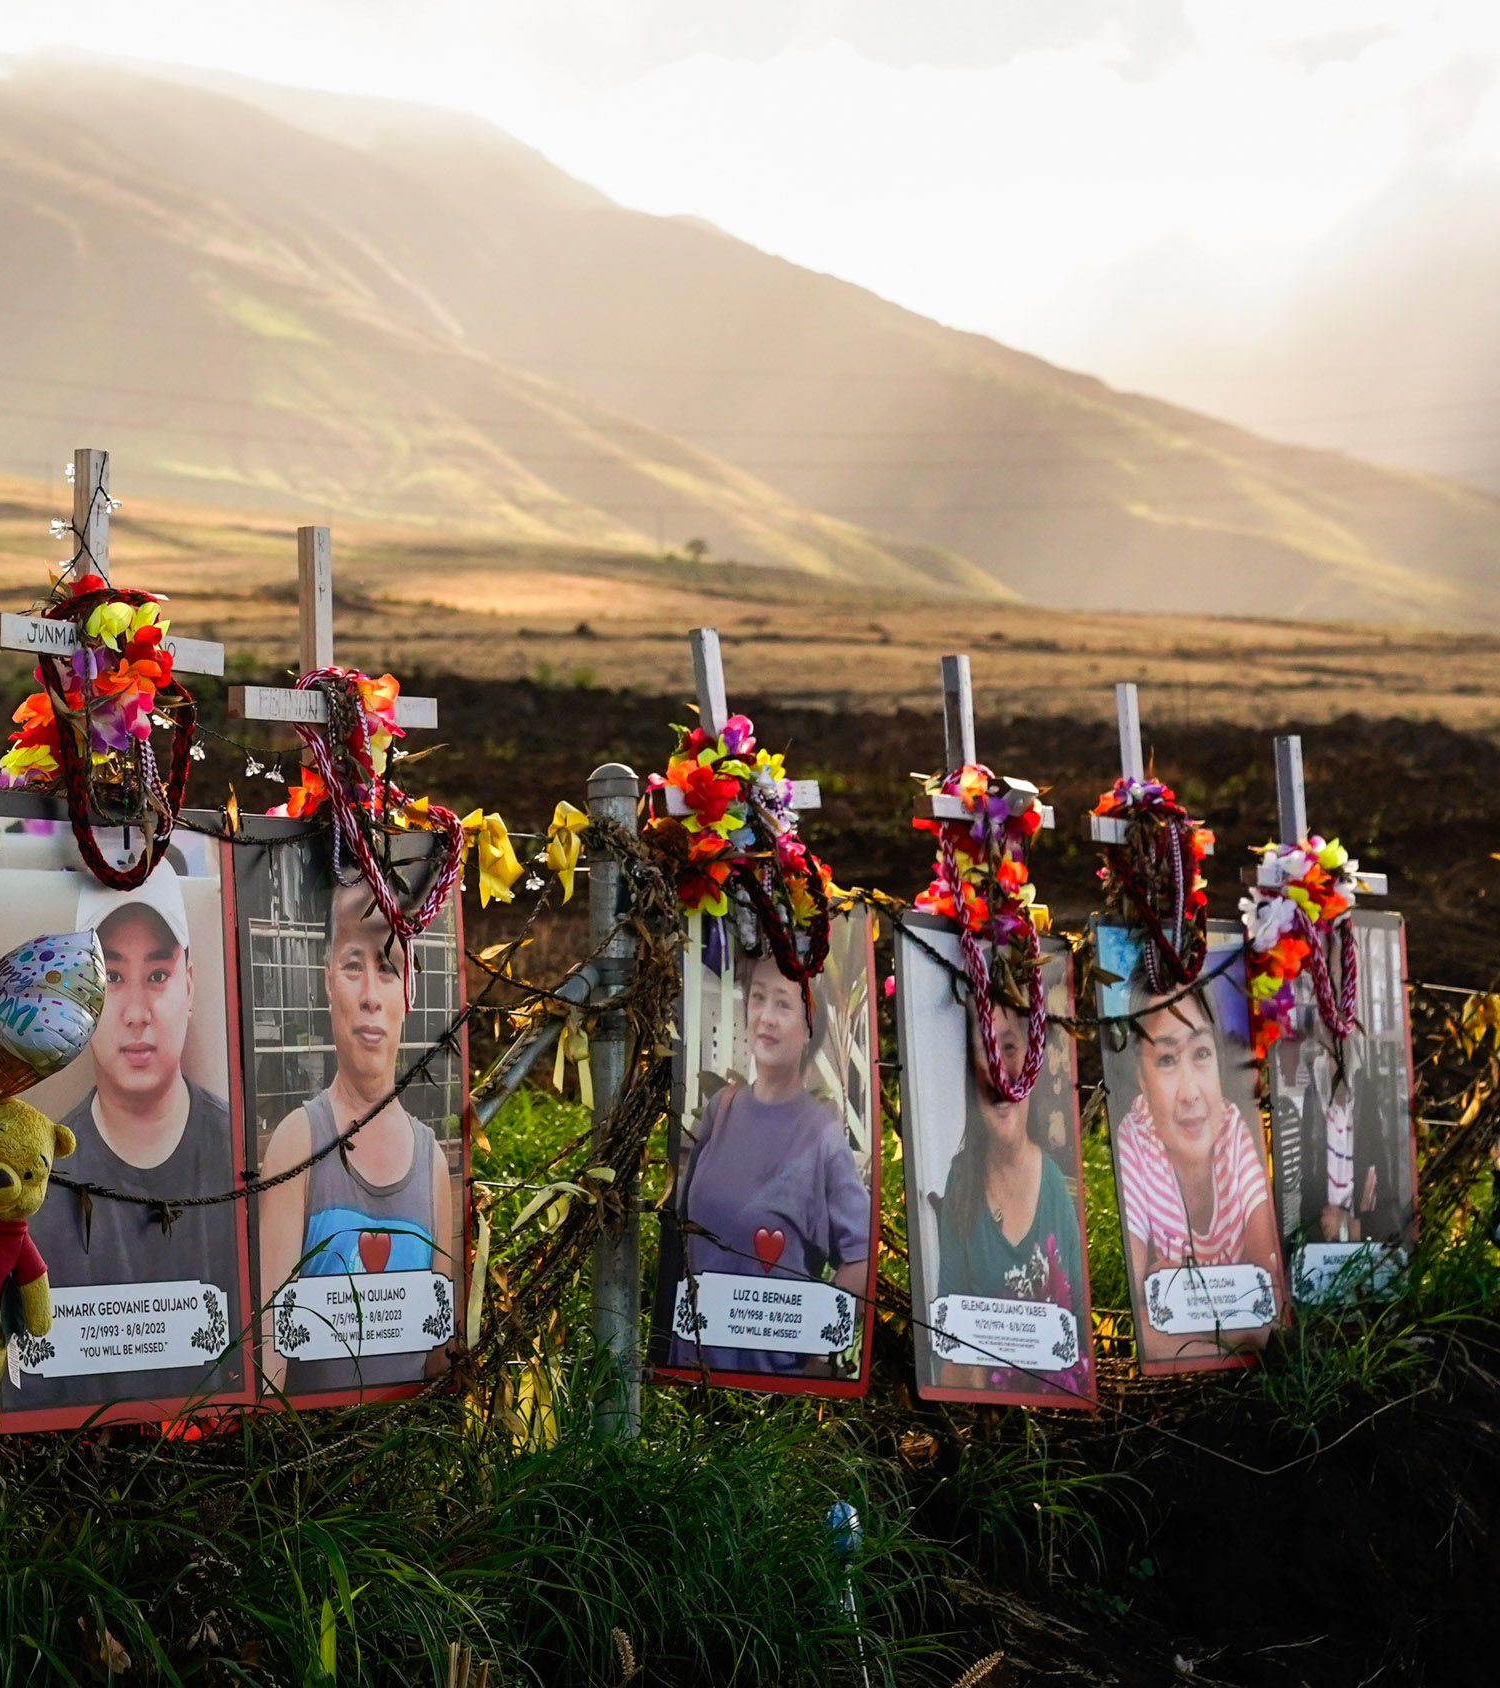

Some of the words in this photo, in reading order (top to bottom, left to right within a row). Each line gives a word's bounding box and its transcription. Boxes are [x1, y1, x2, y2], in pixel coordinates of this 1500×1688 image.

[326, 1290, 366, 1305] FELIMN
[367, 1287, 406, 1301] QUIJANO
[733, 1289, 750, 1302] LUZ
[762, 1292, 803, 1306] BERNABE
[98, 1299, 150, 1316] GEOVANIE
[152, 1296, 198, 1312] QUIJANO
[961, 1300, 991, 1311] GLENDA
[991, 1302, 1024, 1315] QUIJANO
[331, 1311, 363, 1326] 7/5/196
[369, 1309, 402, 1323] 8/8/2023
[769, 1312, 803, 1324] 8/8/2023
[80, 1325, 119, 1340] 7/2/1993
[126, 1322, 166, 1337] 8/8/2023
[366, 1330, 375, 1340] BE
[745, 1326, 762, 1337] WILL
[762, 1328, 772, 1338] BE
[102, 1345, 121, 1356] WILL
[123, 1344, 133, 1355] BE
